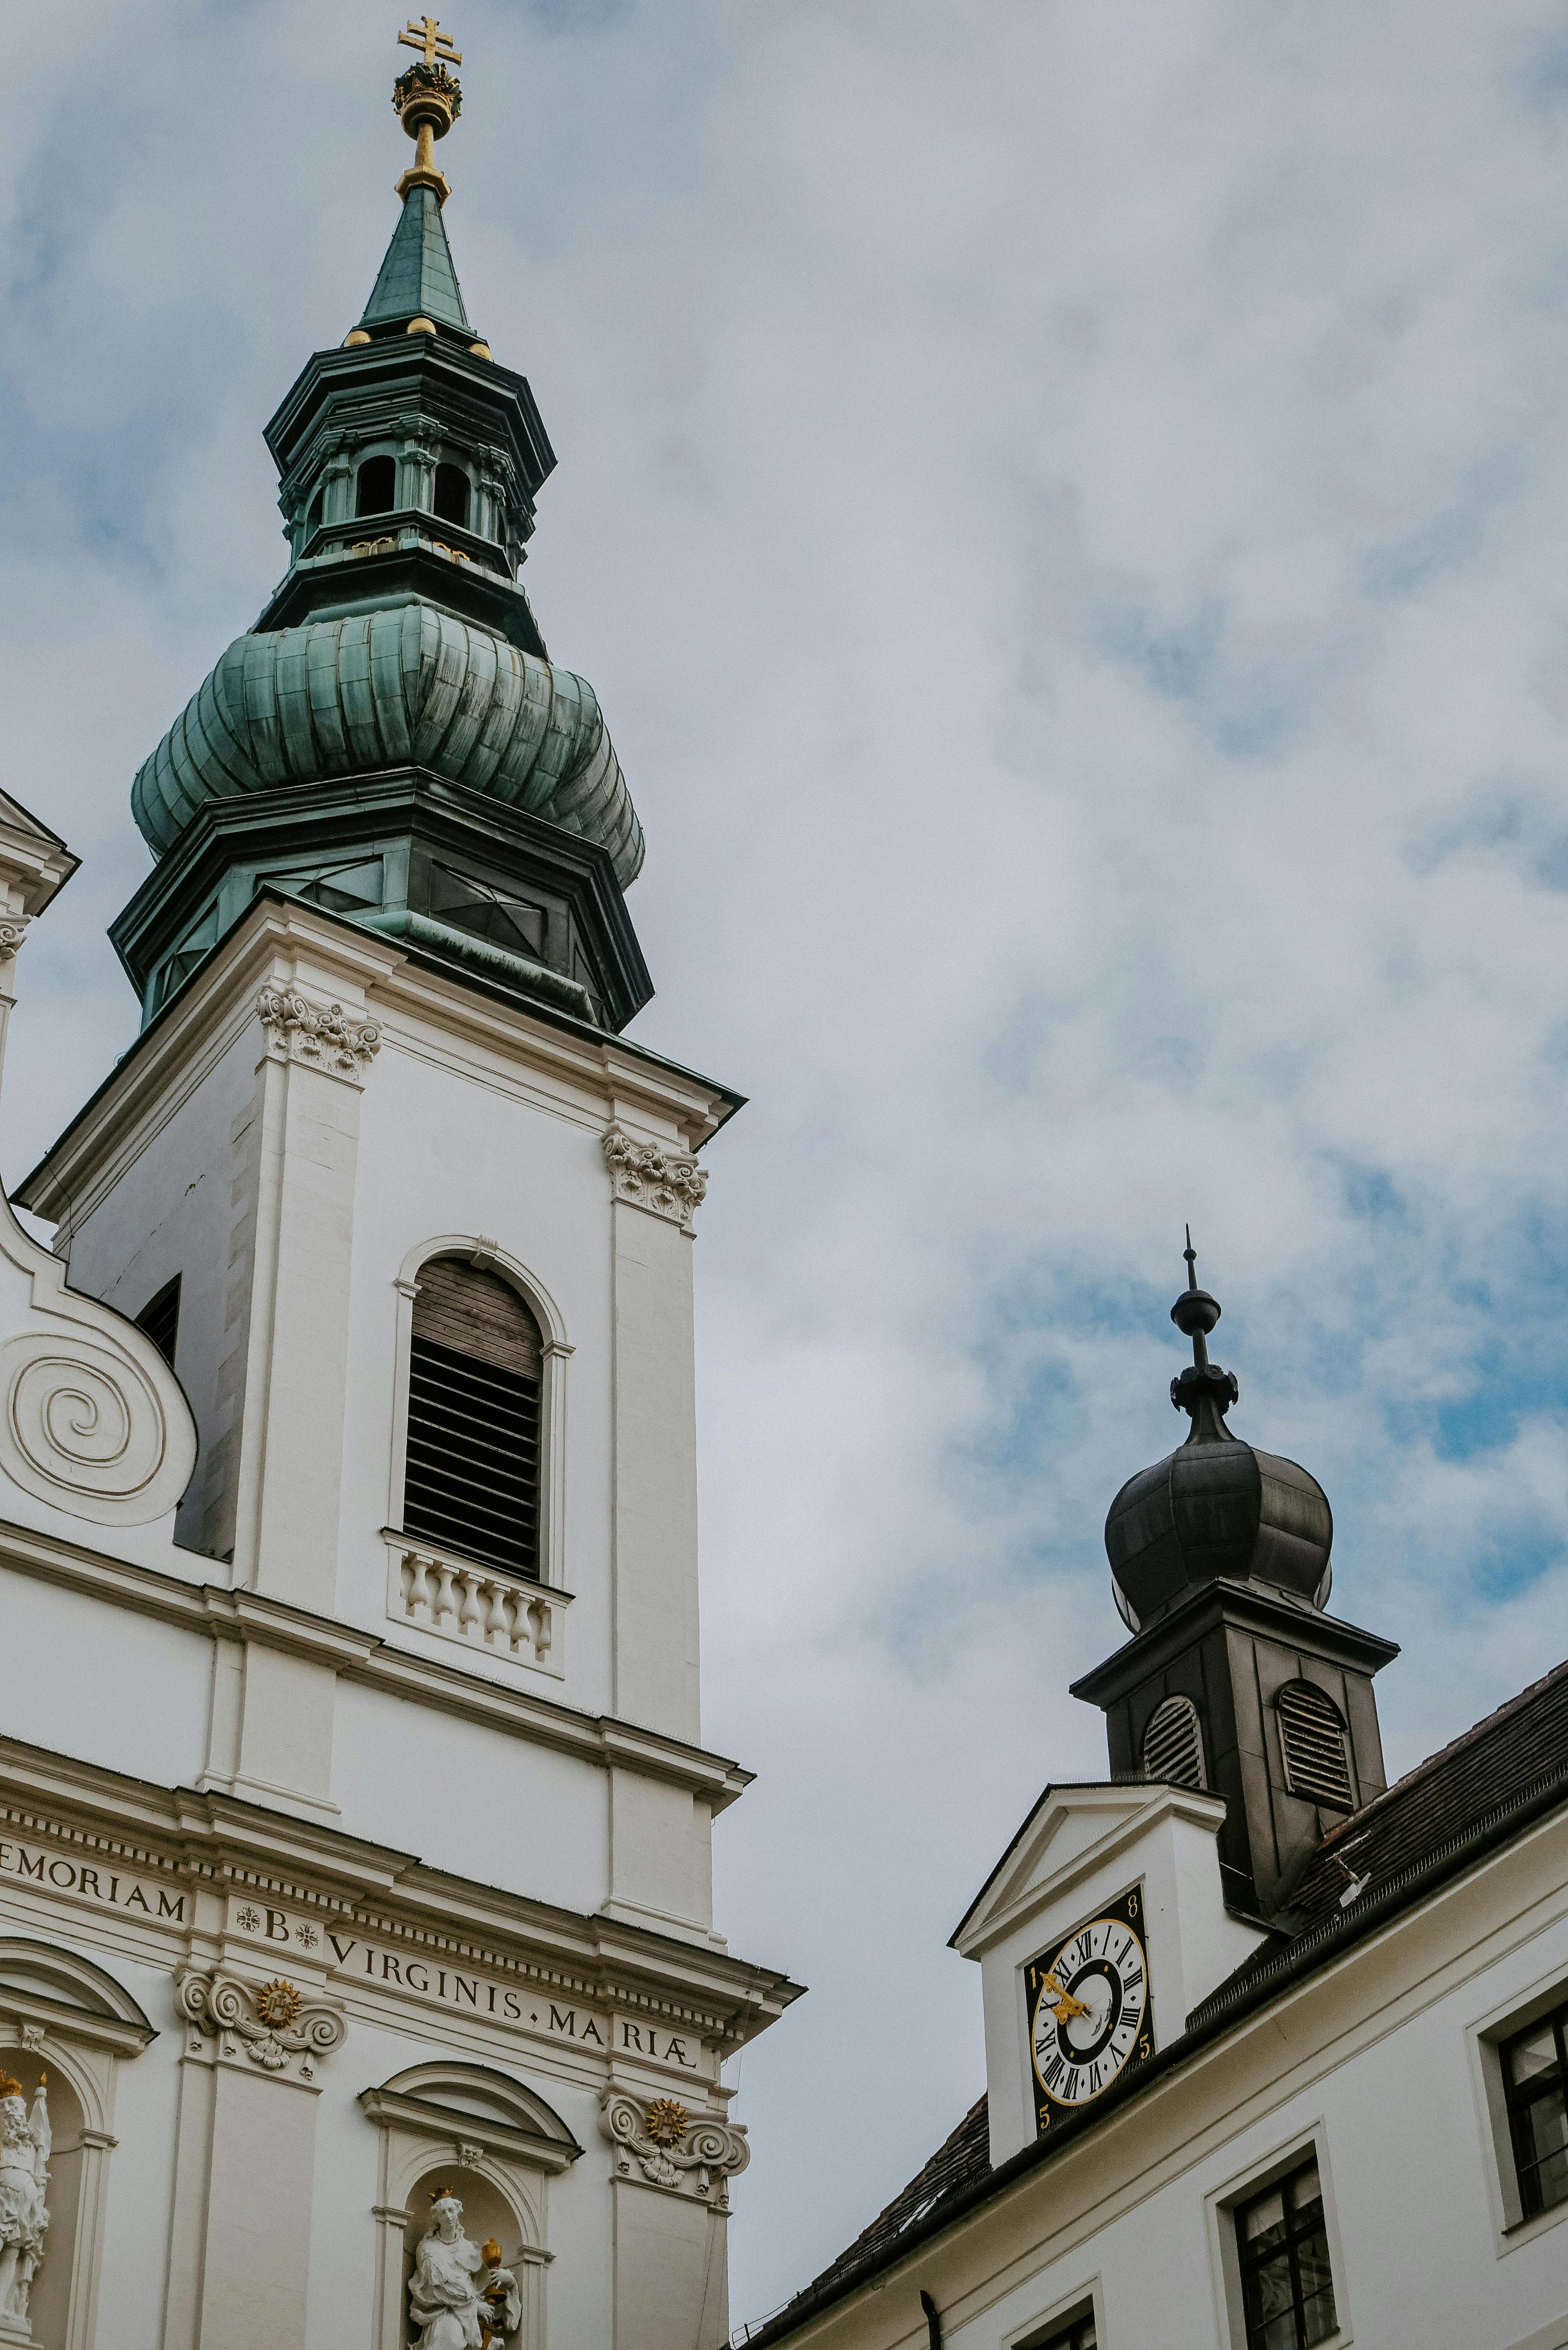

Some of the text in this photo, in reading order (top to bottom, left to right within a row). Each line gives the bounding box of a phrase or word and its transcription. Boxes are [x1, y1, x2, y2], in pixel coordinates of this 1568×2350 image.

[1128, 1895, 1138, 1917] 8
[265, 1909, 289, 1942] B
[1102, 1925, 1112, 1955] I
[1076, 1929, 1092, 1966] XII
[1116, 1936, 1134, 1967] II
[1030, 1967, 1037, 1989] 1
[1053, 1956, 1073, 1987] XI
[1124, 1966, 1142, 1994] III
[1119, 2007, 1140, 2031] IIII
[1036, 2028, 1055, 2057] IX
[1109, 2042, 1126, 2069] V
[1140, 2033, 1150, 2059] 5
[1062, 2067, 1079, 2099] VII
[1090, 2061, 1103, 2095] VI
[1040, 2104, 1049, 2128] 5
